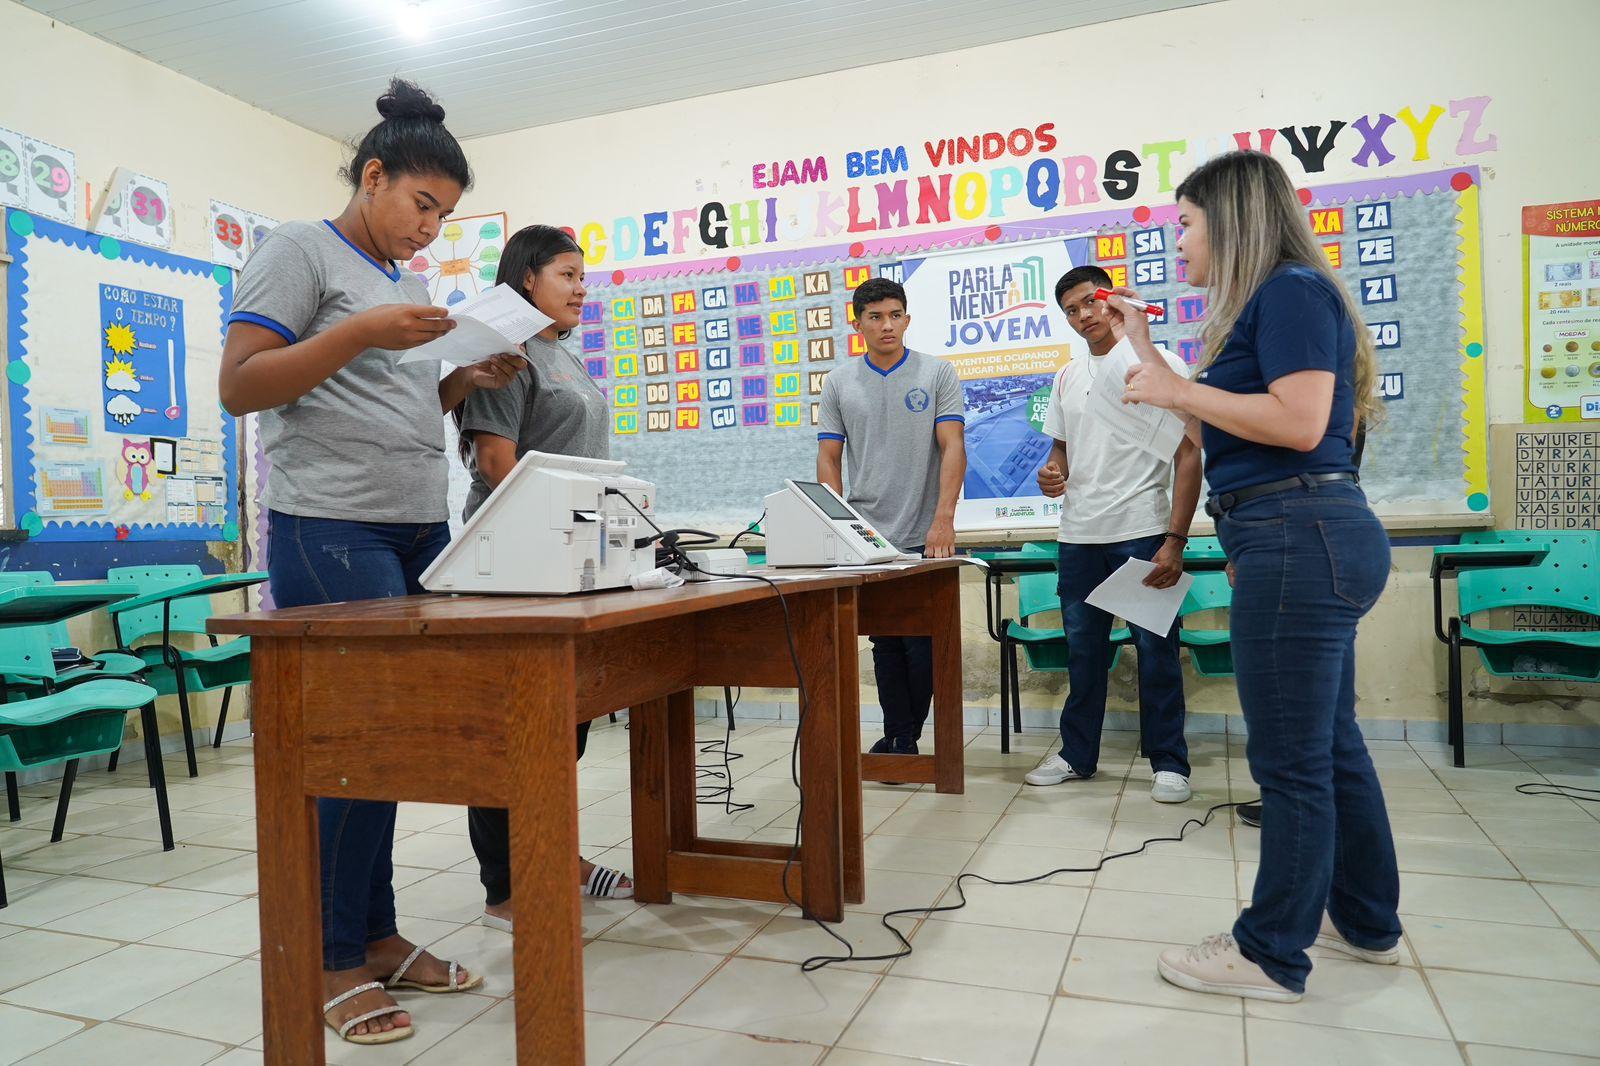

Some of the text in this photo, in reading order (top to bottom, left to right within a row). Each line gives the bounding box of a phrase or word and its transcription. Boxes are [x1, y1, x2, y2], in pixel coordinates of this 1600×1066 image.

[752, 122, 1057, 189] EJAM BEM VINDOS
[580, 222, 608, 265] C
[612, 216, 639, 261] D
[643, 211, 668, 256] E
[672, 207, 697, 254] F
[699, 201, 729, 249] G
[728, 200, 761, 246] H
[765, 197, 778, 242] I
[814, 190, 845, 238] K
[847, 186, 877, 232] L
[874, 179, 910, 230] M
[915, 173, 953, 224] N
[953, 171, 988, 221] O
[987, 165, 1024, 218] P
[1026, 157, 1061, 212] Q
[1062, 154, 1100, 206] R
[1102, 149, 1141, 201] S
[1142, 139, 1187, 193] T
[1278, 120, 1347, 173] W
[1351, 113, 1397, 167] X
[1396, 104, 1446, 162] Y
[1449, 95, 1498, 156] Z
[33, 161, 70, 193] 29
[132, 191, 164, 221] 31
[214, 218, 243, 245] 33
[1546, 207, 1594, 220] SISTEMA
[1312, 206, 1388, 233] XA ZA
[1097, 236, 1124, 258] RA
[1135, 231, 1163, 254] SA
[1360, 239, 1392, 262] ZE
[949, 264, 1013, 295] PARLA
[1136, 261, 1164, 283] SE
[104, 286, 179, 313] COMO ESTAR
[582, 303, 600, 320] BA
[614, 301, 633, 318] CA
[643, 298, 663, 315] DA
[673, 292, 694, 312] FA
[703, 289, 726, 308] GA
[736, 285, 758, 304] HA
[771, 280, 793, 298] JA
[805, 274, 829, 294] KA
[845, 268, 869, 288] LA
[1366, 278, 1392, 300] ZI
[115, 307, 124, 321] O
[131, 309, 167, 328] TEMPO
[1181, 299, 1203, 319] TI
[584, 333, 603, 349] BE
[615, 329, 636, 346] CE
[644, 328, 665, 345] DE
[674, 325, 696, 343] FE
[706, 320, 728, 339] GE
[739, 318, 761, 336] HE
[772, 313, 794, 332] JE
[807, 308, 831, 329] KE
[945, 315, 1051, 348] JOVEM
[588, 361, 603, 376] BI
[619, 358, 632, 374] CI
[646, 355, 664, 373] DI
[678, 352, 696, 370] FI
[709, 350, 726, 367] GI
[743, 347, 760, 363] HI
[776, 344, 793, 361] JI
[811, 340, 829, 359] KI
[963, 366, 994, 376] LUGAR
[996, 364, 1010, 373] NA
[1012, 360, 1056, 371] POLÍTICA
[1004, 350, 1059, 362] OCUPANDO
[617, 388, 637, 404] CO
[648, 384, 668, 402] DO
[677, 382, 698, 400] FO
[708, 380, 731, 397] GO
[744, 378, 766, 396] HO
[776, 376, 798, 394] JO
[616, 414, 636, 430] CU
[649, 412, 669, 429] DU
[677, 409, 698, 427] FU
[712, 407, 735, 427] GU
[744, 406, 767, 423] HU
[777, 406, 799, 423] JU
